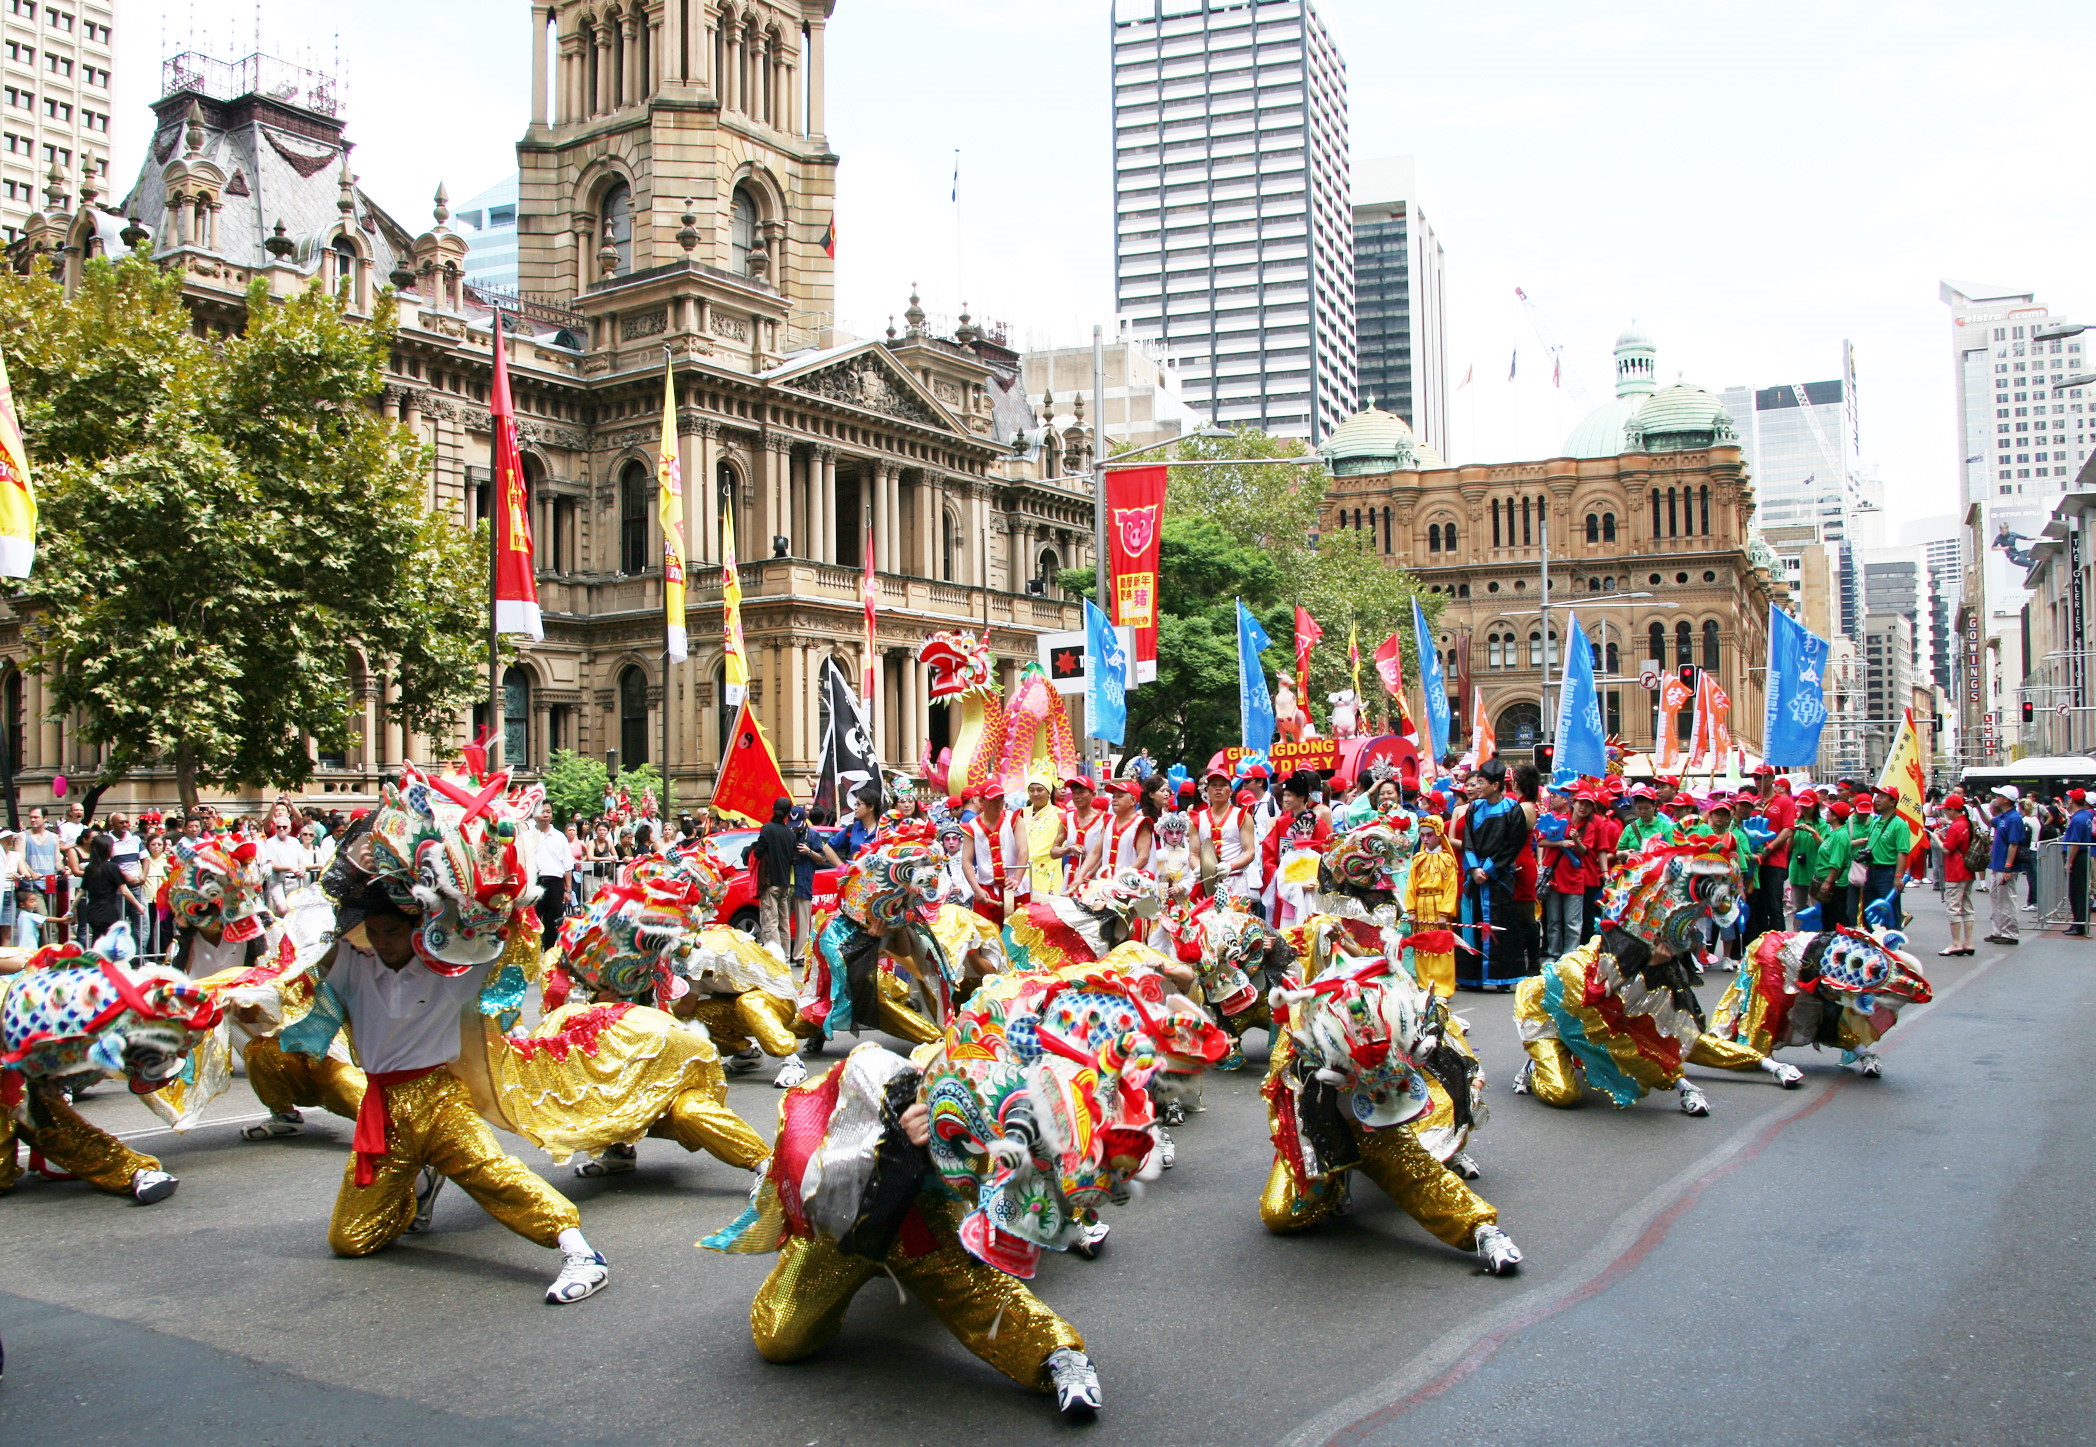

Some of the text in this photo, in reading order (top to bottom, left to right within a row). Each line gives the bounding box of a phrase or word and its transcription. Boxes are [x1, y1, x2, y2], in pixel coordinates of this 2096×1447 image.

[1955, 313, 2001, 325] Telstra
[2073, 570, 2081, 631] GALERIES
[1969, 618, 1978, 701] GOWINGS
[1087, 656, 1097, 731] Nanhai Passion
[1557, 677, 1577, 762] Nanhai Passion
[1769, 671, 1781, 711] Nanhai
[1227, 740, 1334, 760] GUGDONG
